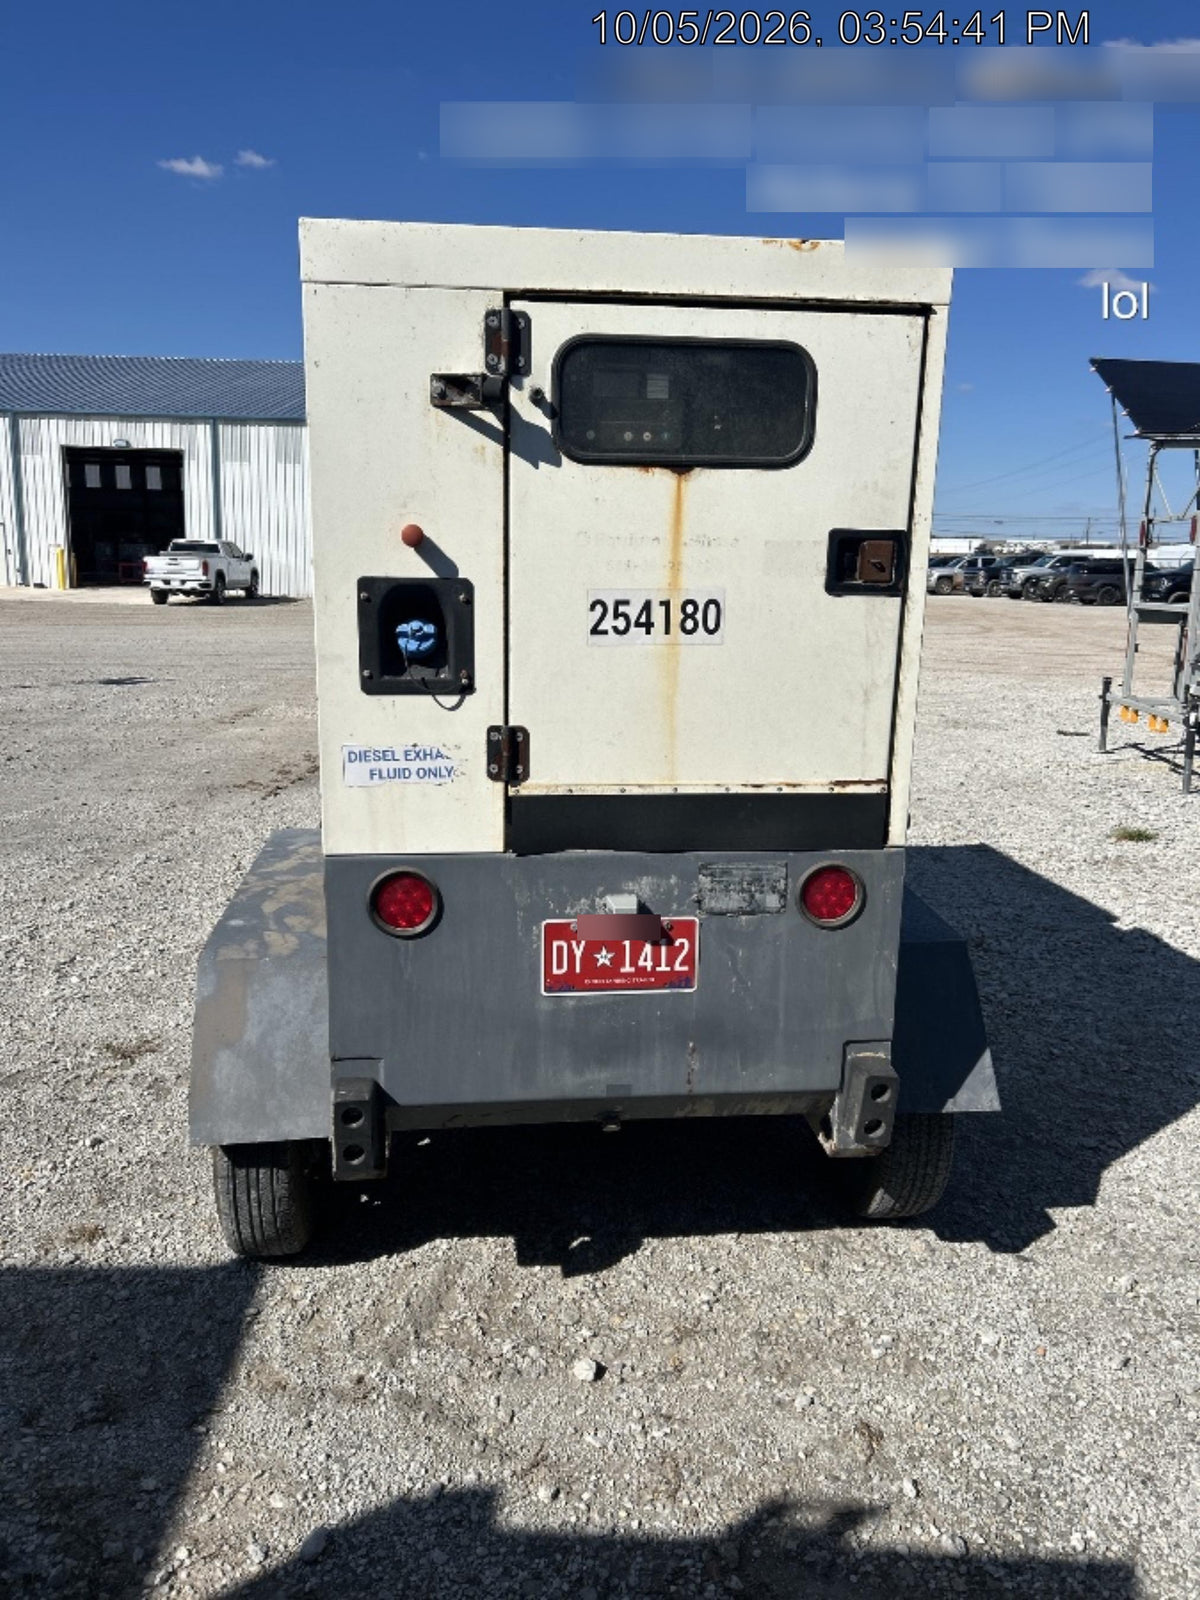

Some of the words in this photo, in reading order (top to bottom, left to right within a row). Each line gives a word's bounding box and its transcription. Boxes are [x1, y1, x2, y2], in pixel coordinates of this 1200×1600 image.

[589, 598, 722, 636] 254180
[347, 749, 400, 763] DIESEL
[403, 747, 452, 762] EXHA
[369, 767, 412, 781] FLUID
[416, 765, 455, 780] ONLY
[552, 940, 586, 975] DY
[620, 938, 690, 974] 1412
